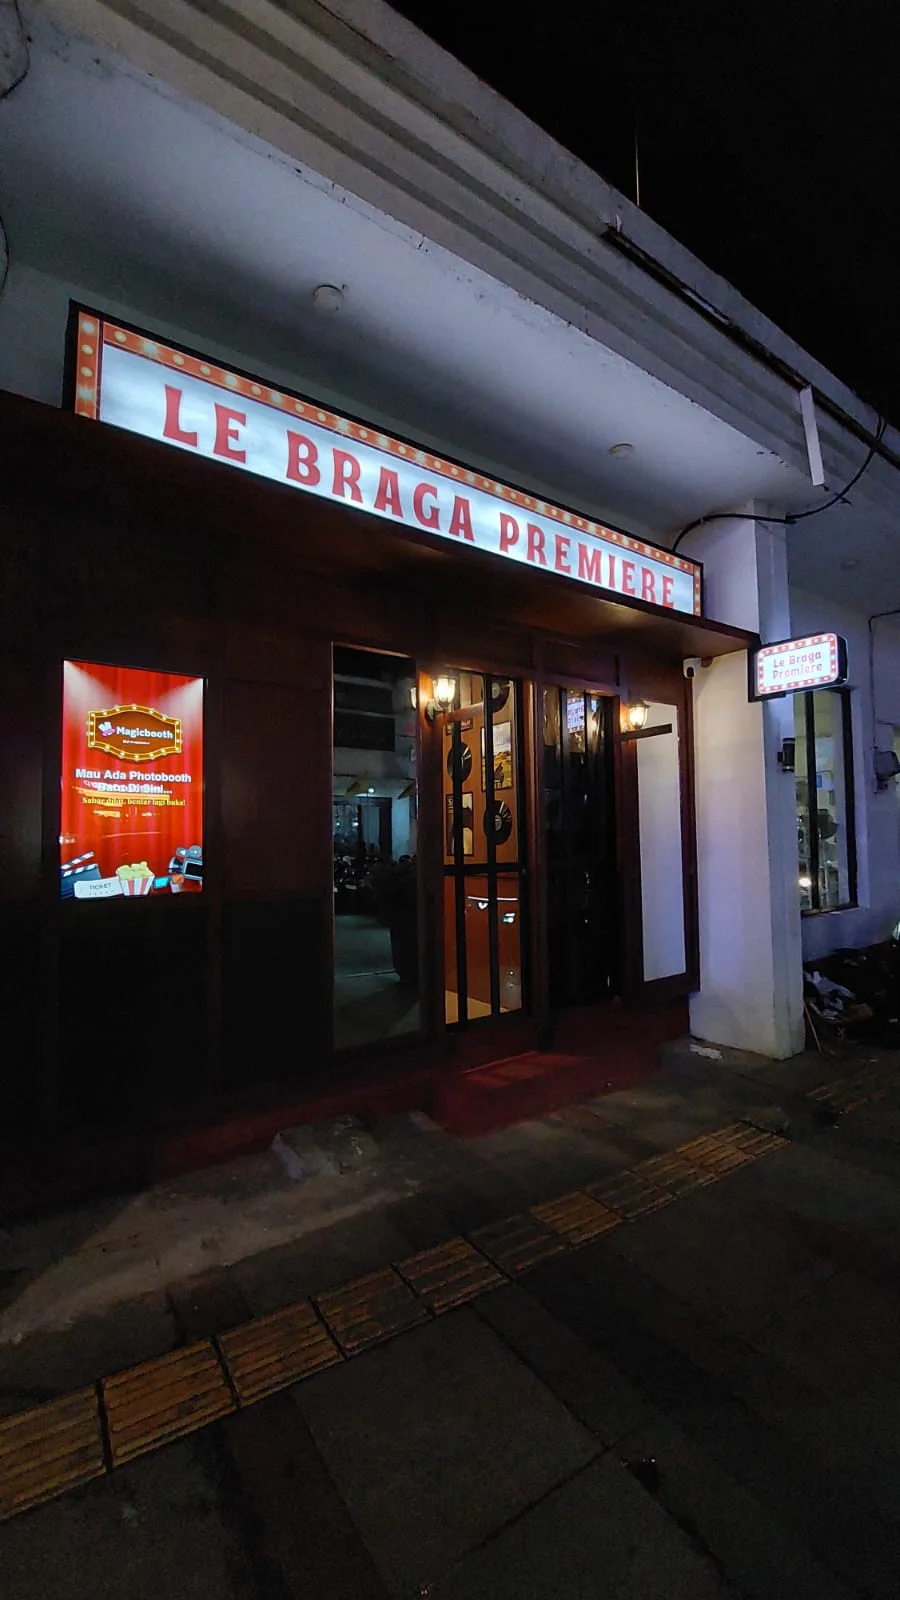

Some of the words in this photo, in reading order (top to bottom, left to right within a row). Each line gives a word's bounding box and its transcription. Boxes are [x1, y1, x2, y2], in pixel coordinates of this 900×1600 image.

[161, 383, 247, 464] LE
[285, 430, 475, 542] BRAGA
[499, 512, 676, 610] PREMIERE
[773, 658, 785, 668] Le
[789, 651, 822, 665] Braga
[772, 663, 823, 681] Premiere
[116, 726, 174, 739] Magicbooth
[75, 768, 101, 779] Mau
[103, 769, 127, 780] Ada
[129, 770, 192, 783] Photobooth
